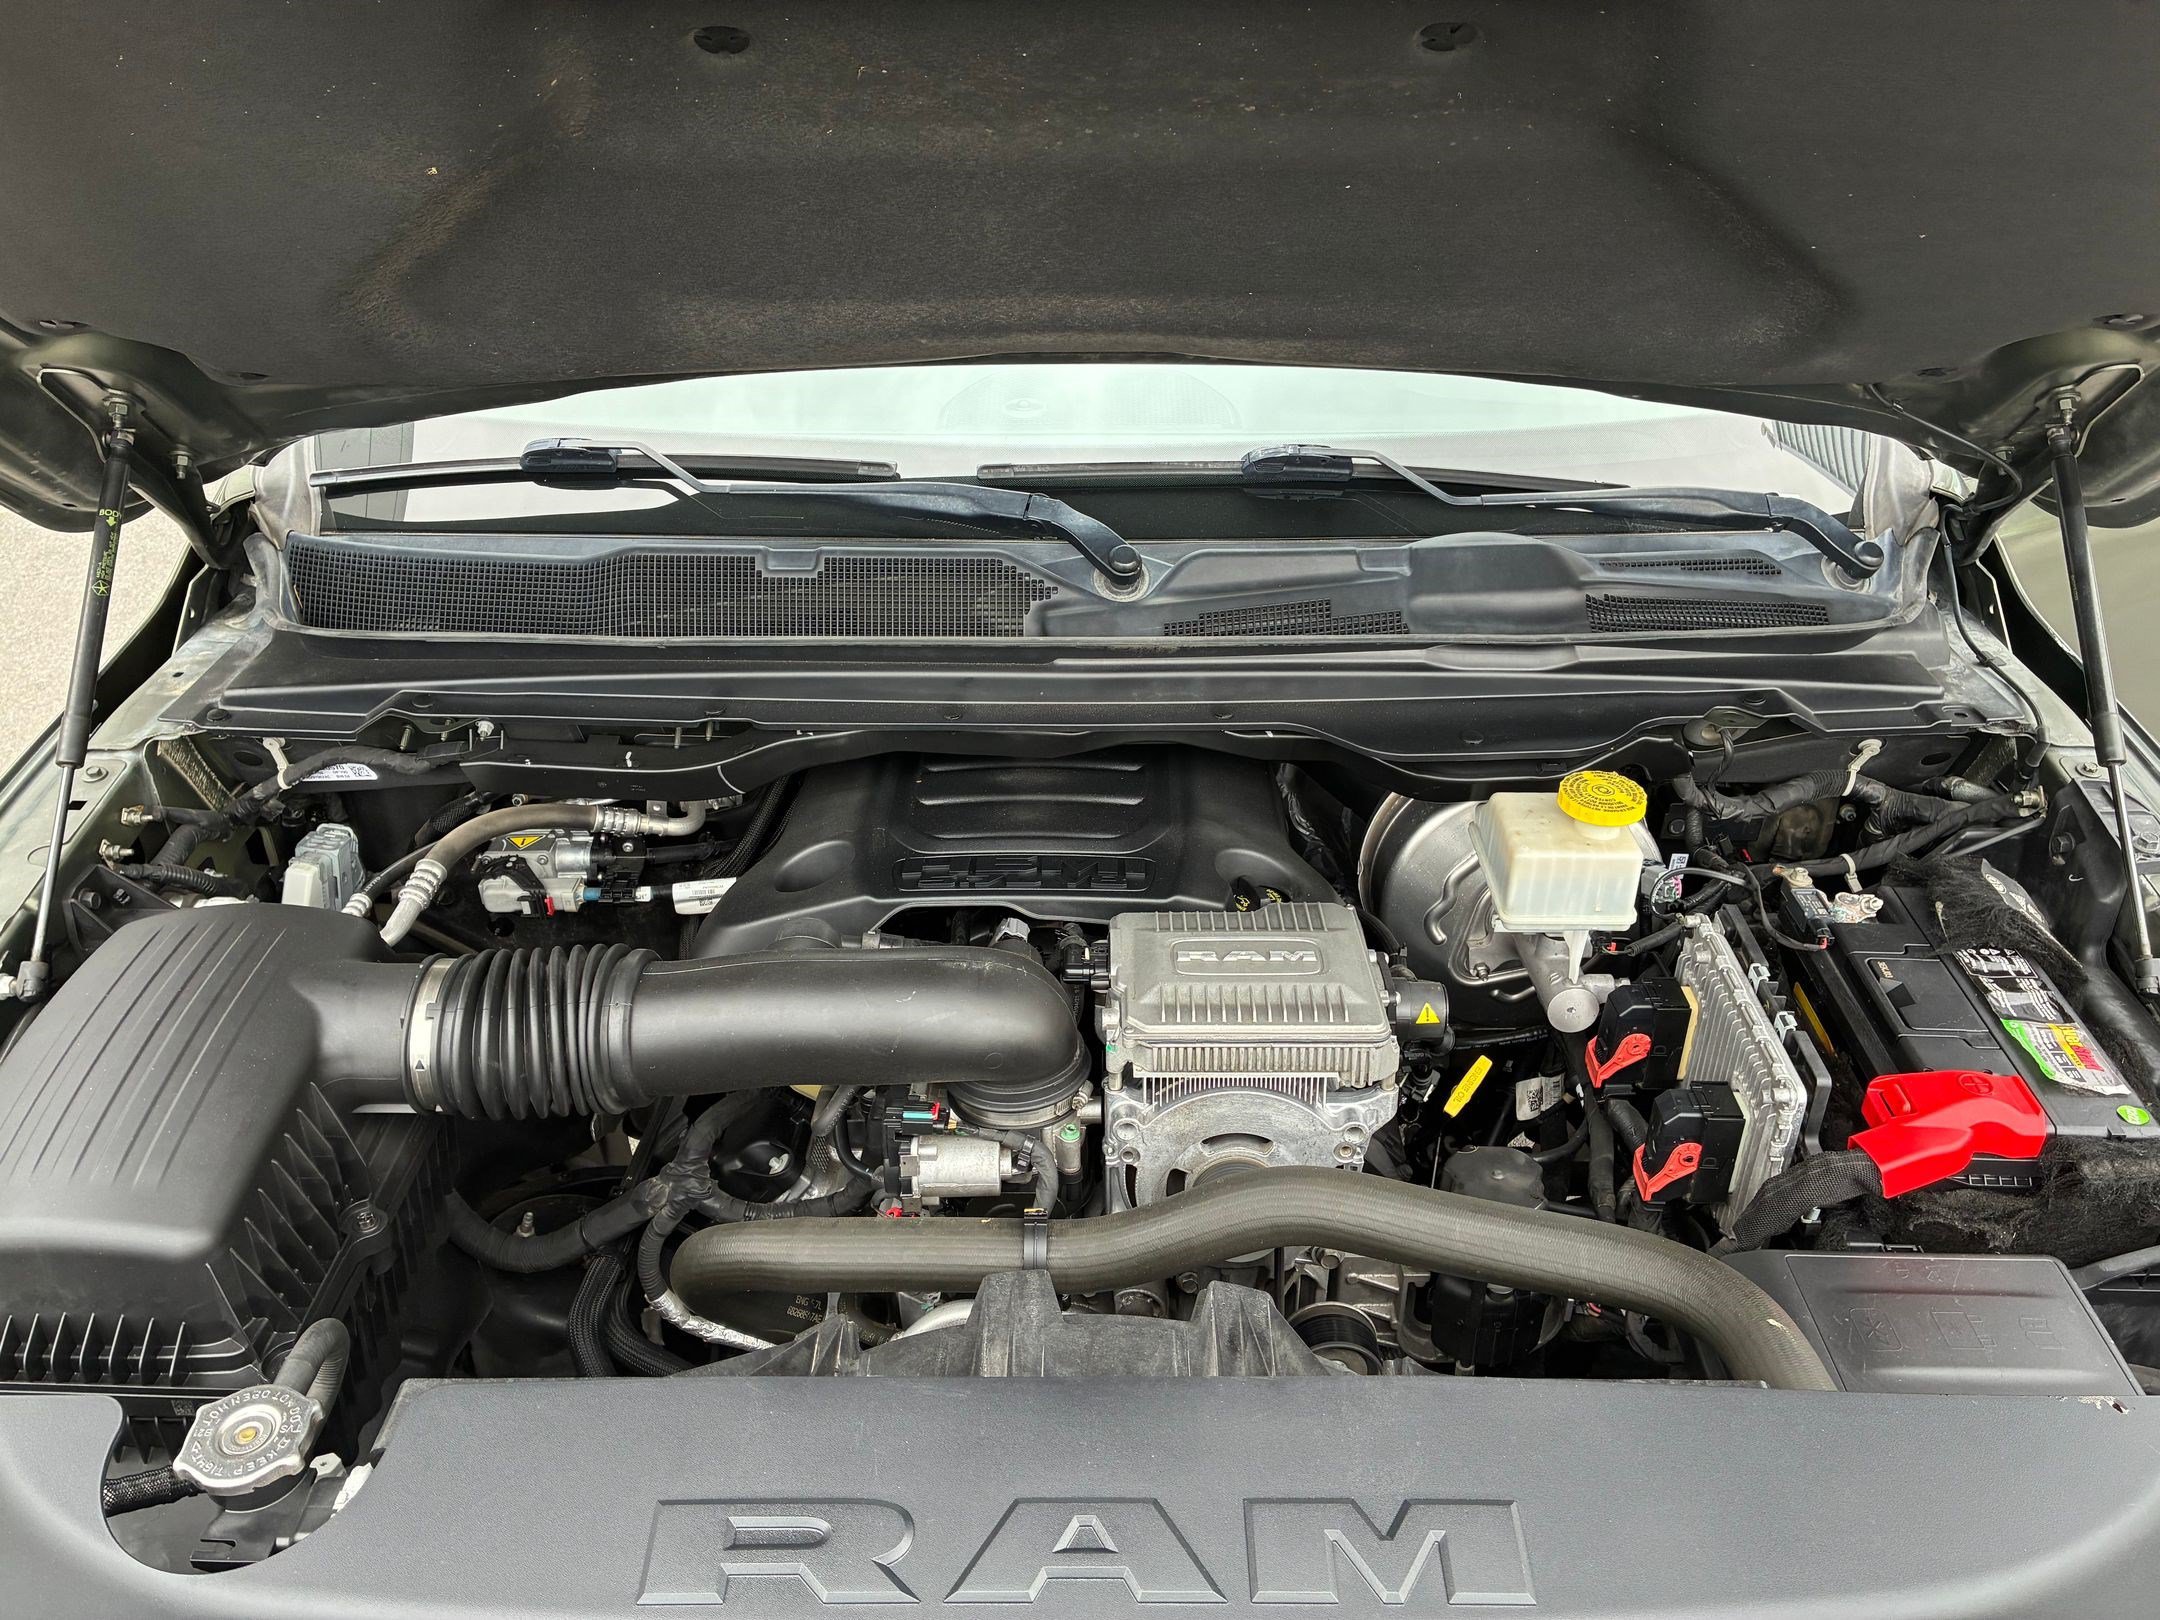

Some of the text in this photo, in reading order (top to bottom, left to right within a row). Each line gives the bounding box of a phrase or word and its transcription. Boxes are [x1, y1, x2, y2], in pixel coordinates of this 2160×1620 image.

[1176, 950, 1318, 962] RAM
[1453, 1066, 1483, 1103] ENGINE OIL
[231, 1389, 271, 1406] OPEN
[272, 1391, 295, 1408] NOT
[203, 1402, 230, 1426] HOT
[190, 1450, 278, 1477] KEEP TIGHT
[637, 1497, 1537, 1607] RAM
